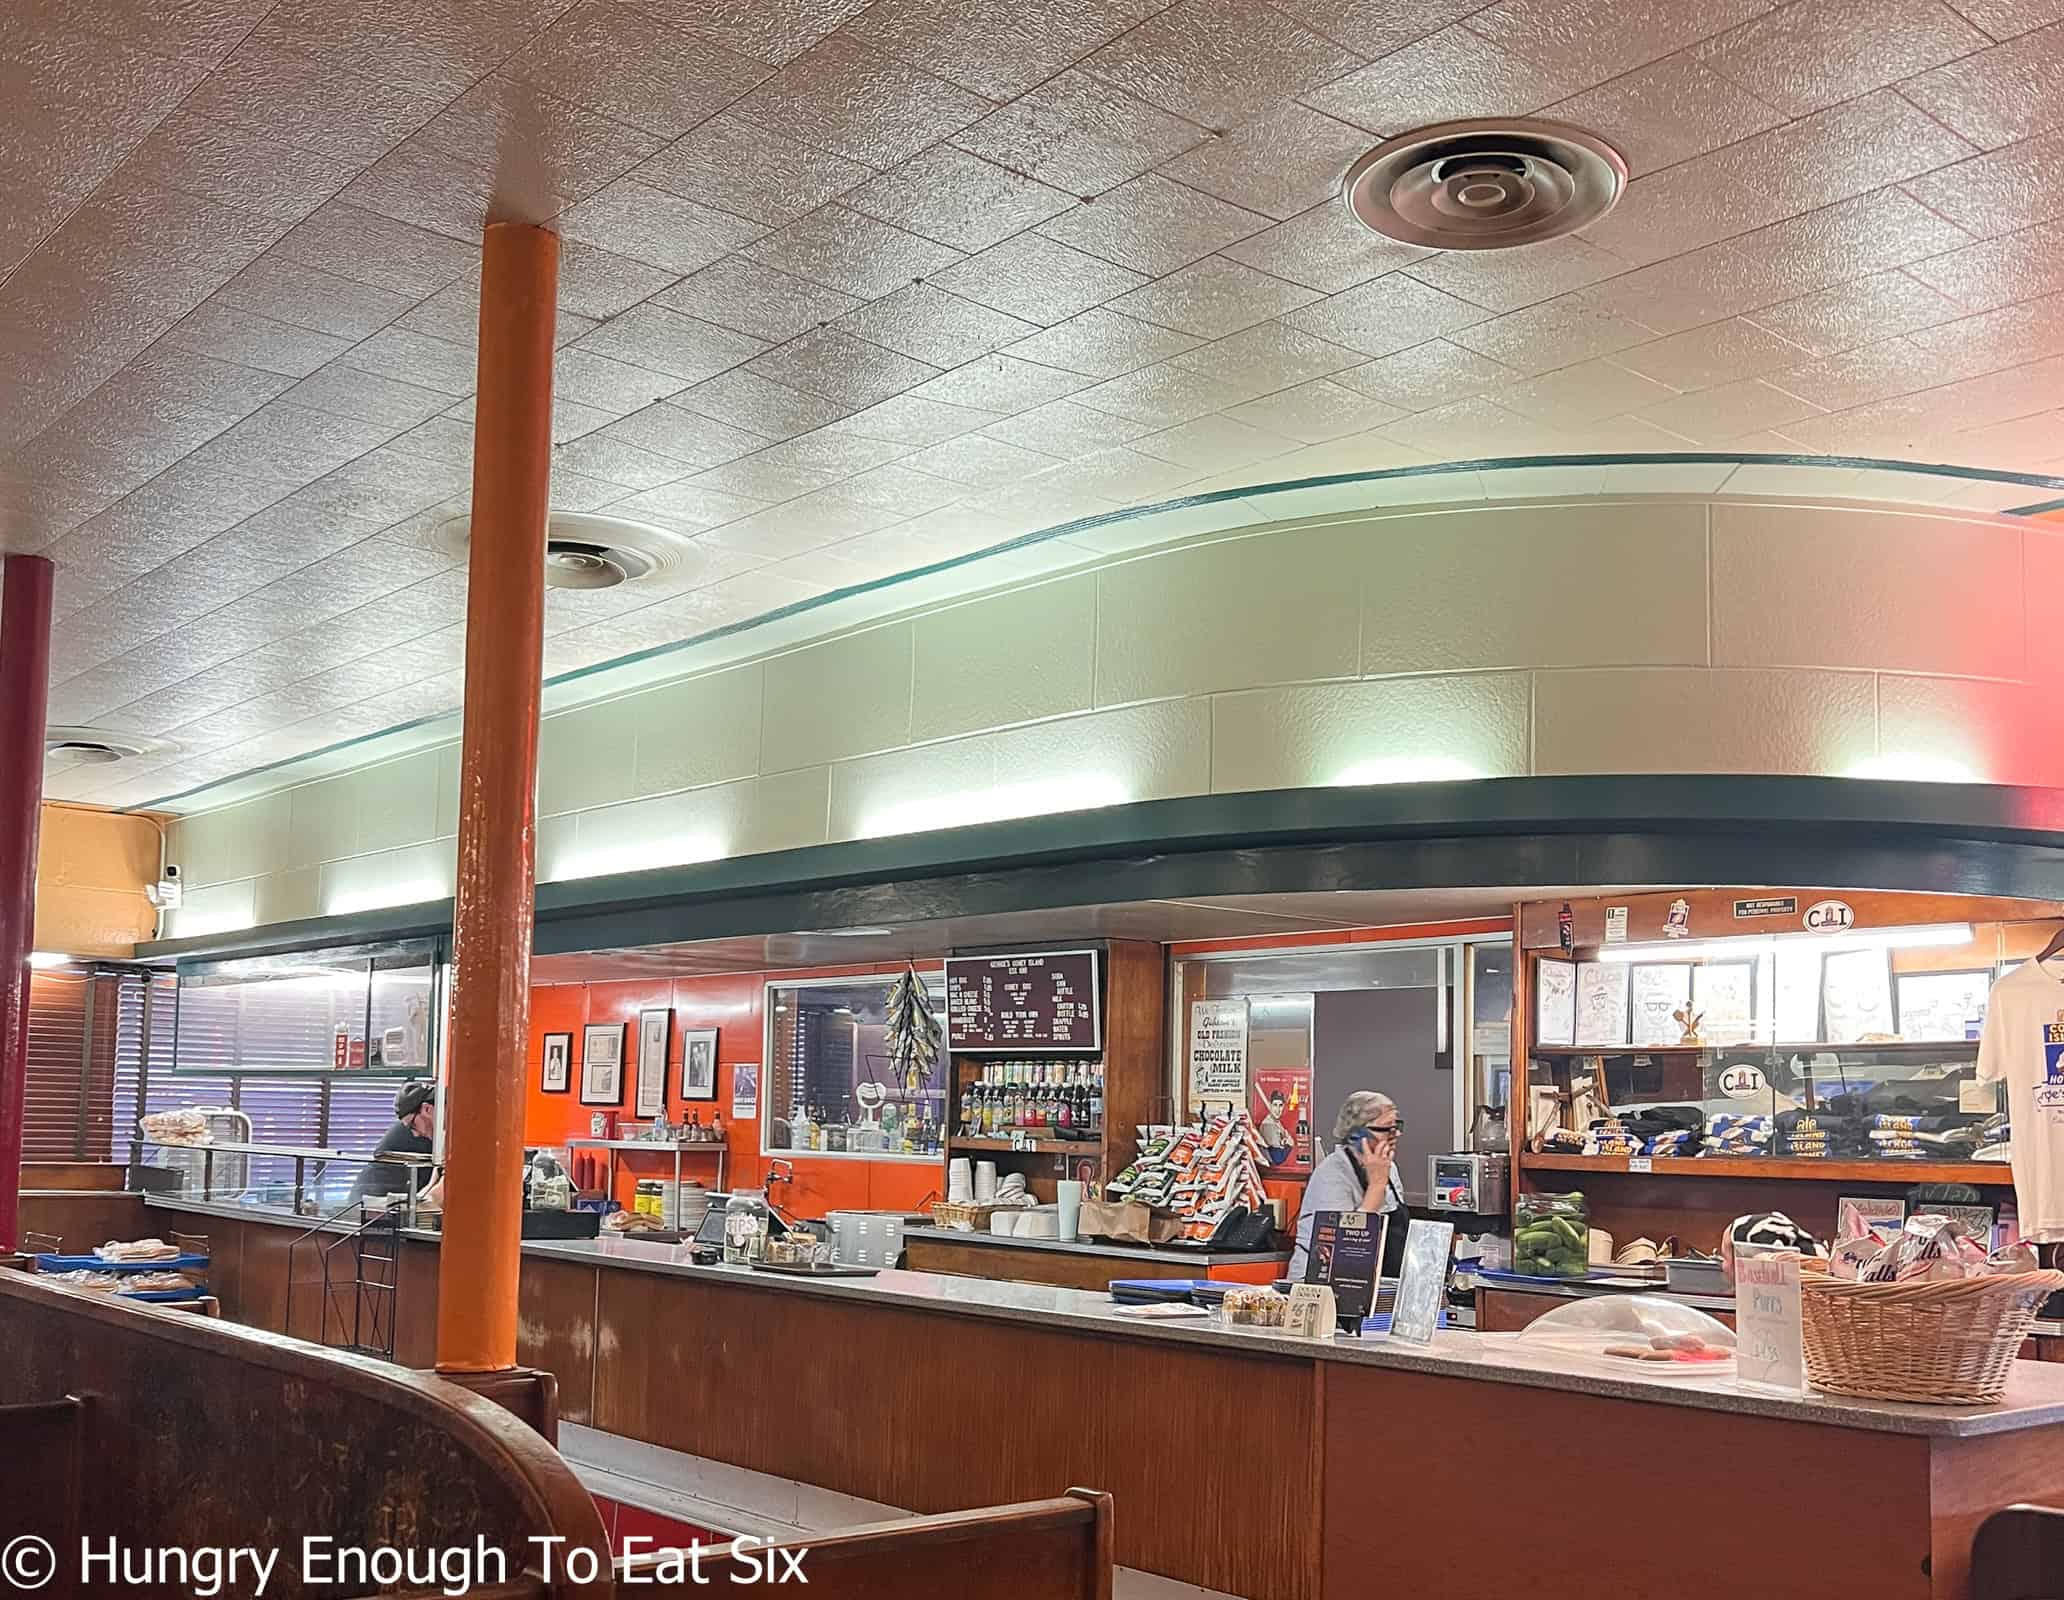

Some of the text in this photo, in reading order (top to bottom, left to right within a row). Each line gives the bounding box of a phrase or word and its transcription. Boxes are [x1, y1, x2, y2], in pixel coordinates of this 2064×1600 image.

[1197, 1030, 1210, 1040] OLD
[1194, 1050, 1242, 1062] CHOCOLATE
[1212, 1063, 1241, 1074] MILK
[1345, 1229, 1360, 1237] TWO
